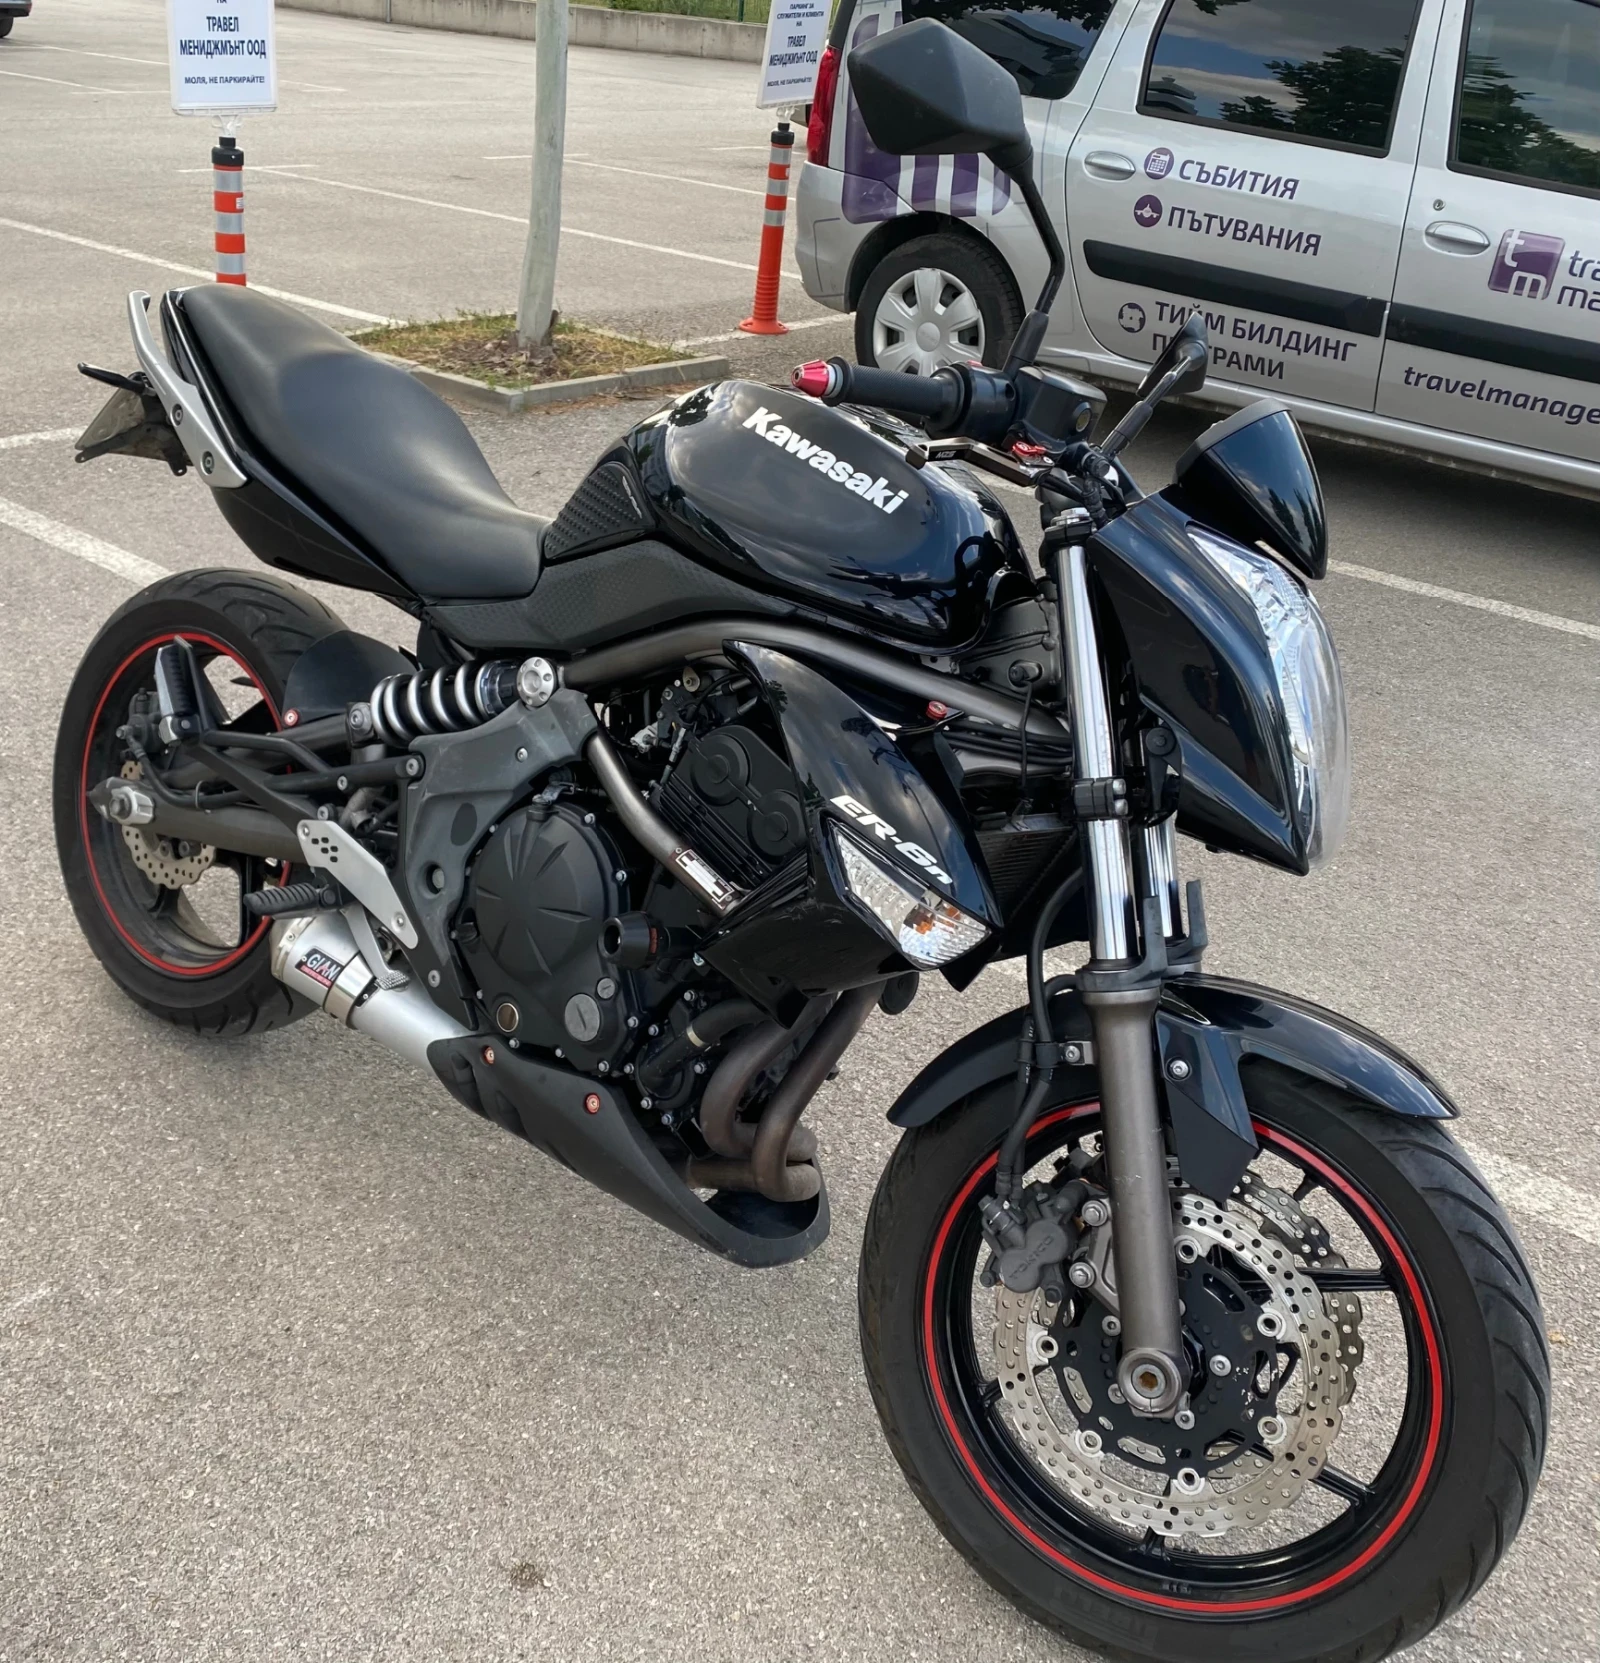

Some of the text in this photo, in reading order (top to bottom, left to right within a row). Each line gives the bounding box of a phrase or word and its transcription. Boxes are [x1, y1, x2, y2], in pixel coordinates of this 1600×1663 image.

[206, 16, 239, 32] ТРАВЕЛ
[787, 35, 806, 47] ТРАВЕЛ
[180, 40, 266, 59] МЕНИДЖМЪНТ ООД
[806, 50, 818, 65] ООД
[185, 77, 207, 85] МОЛЯ,
[219, 75, 265, 84] ПАРКИРАЙТЕ!
[1179, 159, 1299, 200] СЪБИТИЯ
[1168, 206, 1321, 256] ПЪТУВАНИЯ
[1152, 333, 1284, 379] ПРАМИ
[1232, 318, 1357, 361] БИЛДИНГ
[1404, 366, 1600, 425] travelmanage
[742, 406, 909, 514] Kawasaki
[830, 795, 953, 885] ER-6n
